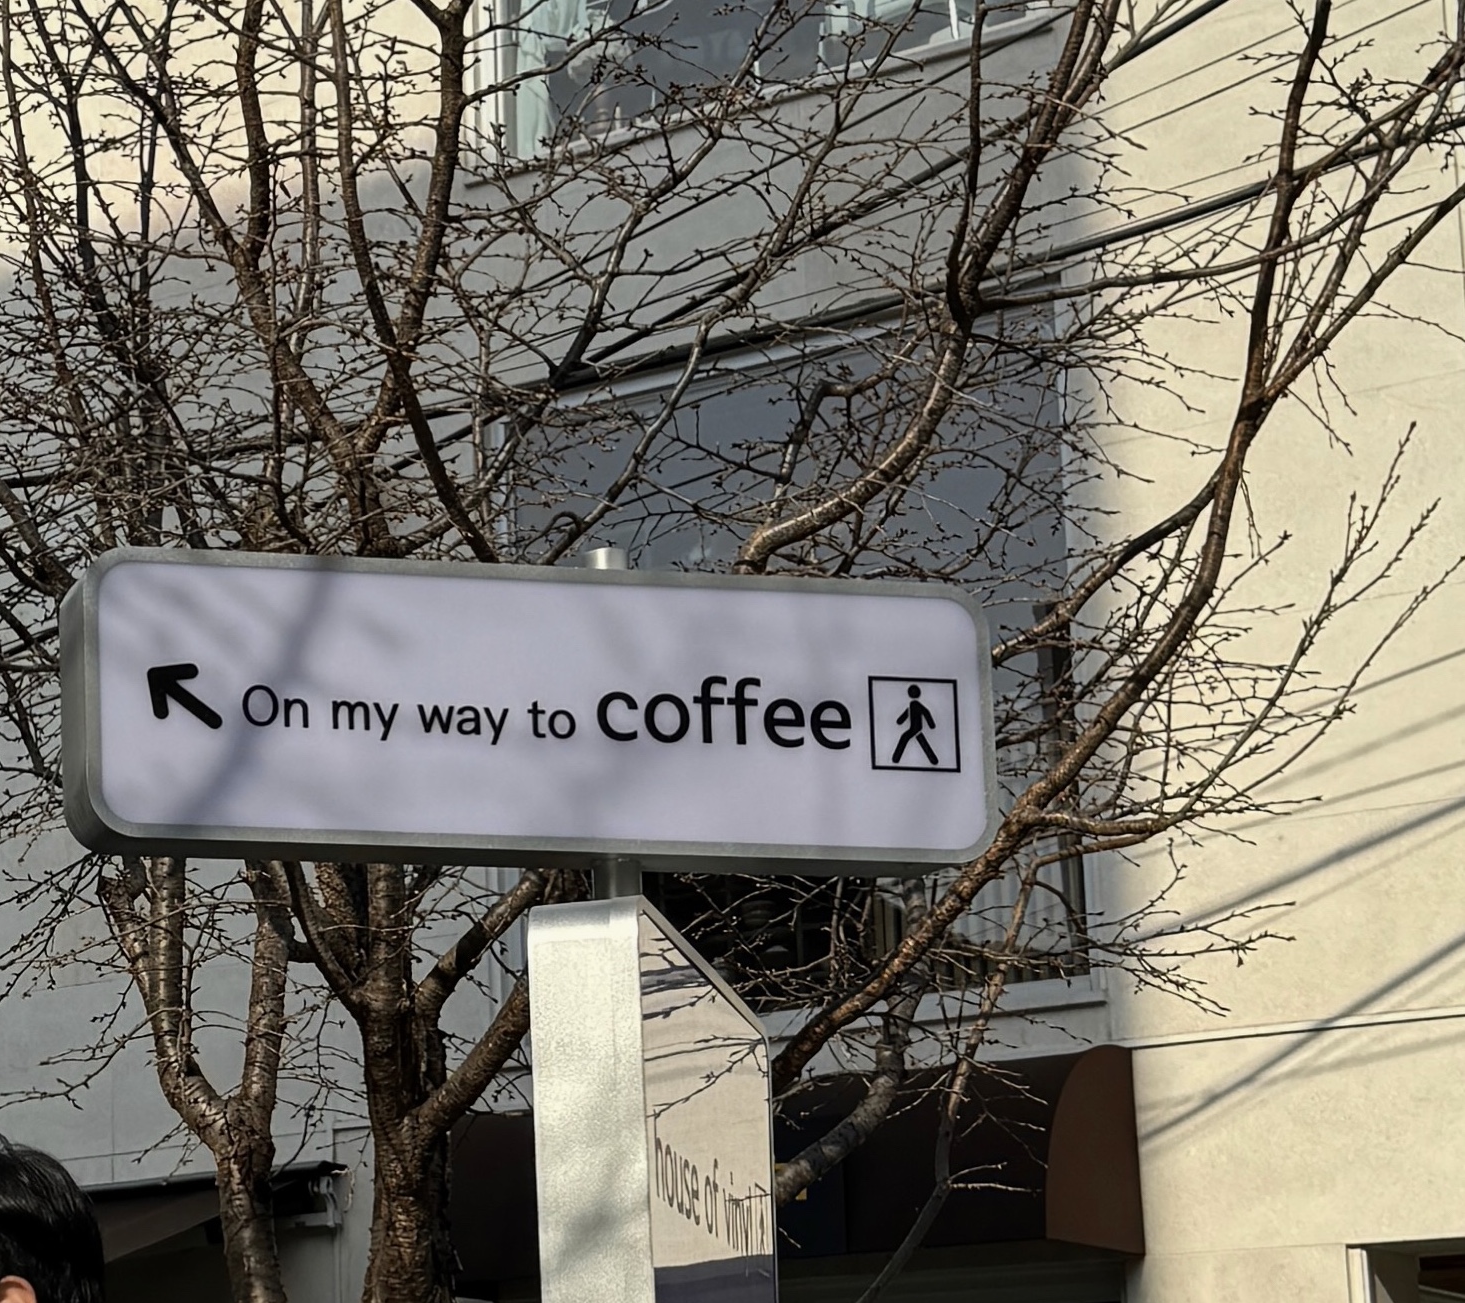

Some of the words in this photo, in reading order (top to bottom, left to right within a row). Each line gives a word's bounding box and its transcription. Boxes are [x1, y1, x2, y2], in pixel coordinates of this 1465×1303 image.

[241, 684, 310, 730] On
[331, 700, 400, 742] my
[417, 704, 509, 746] way
[527, 700, 577, 740] to
[596, 675, 852, 751] coffee
[654, 1109, 701, 1227] house
[704, 1157, 719, 1239] of
[722, 1171, 754, 1268] vinyl
